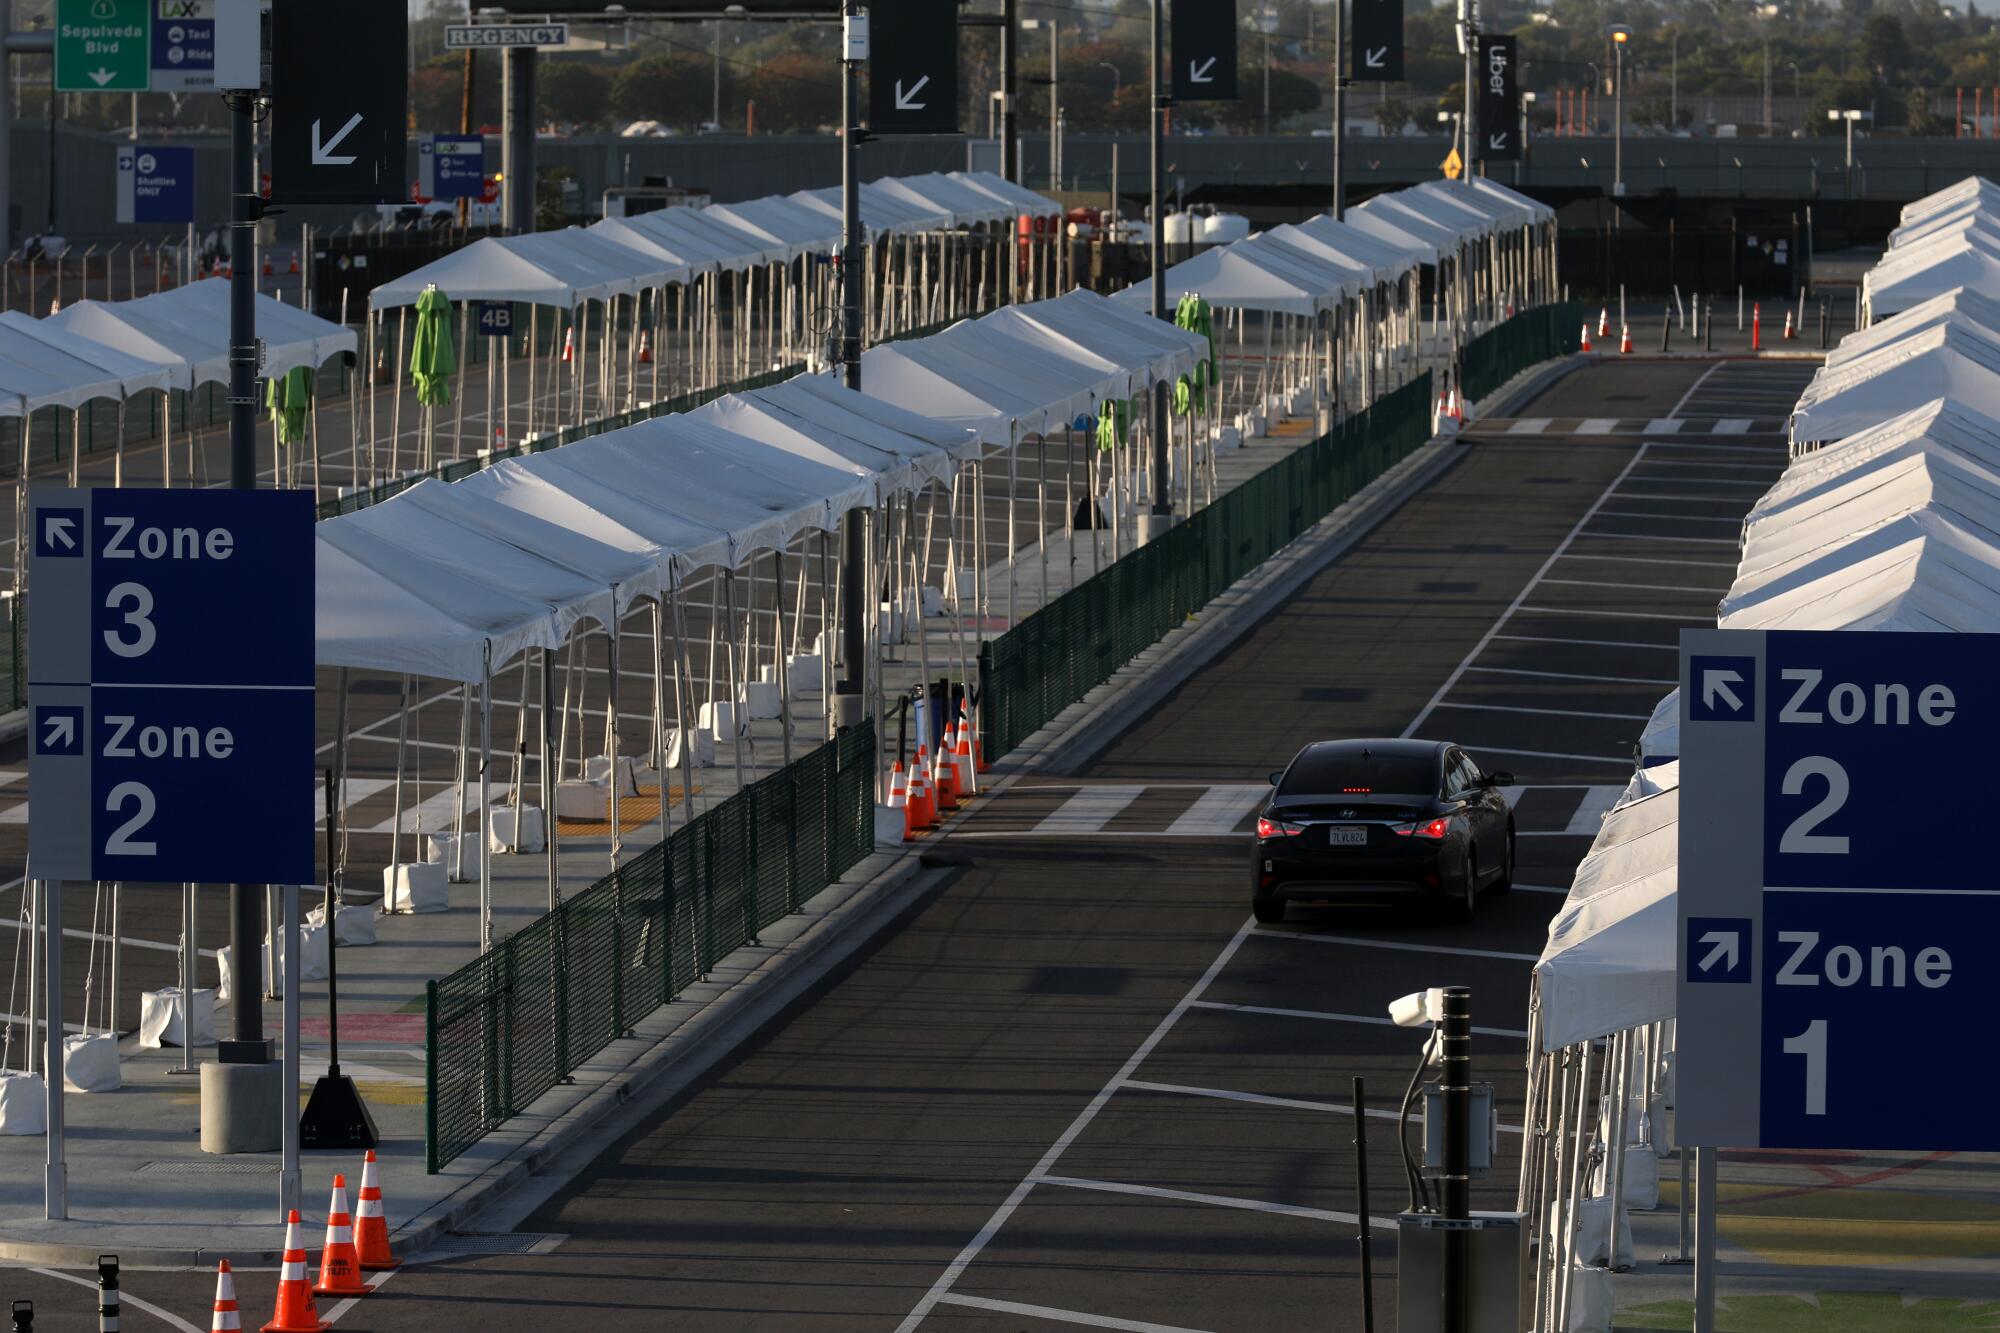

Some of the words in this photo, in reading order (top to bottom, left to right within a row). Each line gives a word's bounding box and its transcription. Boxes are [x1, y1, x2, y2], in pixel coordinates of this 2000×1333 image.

[62, 25, 142, 38] Sepulveda
[85, 41, 119, 53] Blvd
[187, 29, 210, 40] Taxi
[449, 28, 561, 44] REGENCY
[187, 50, 213, 60] Ride
[1489, 45, 1507, 96] Uber
[184, 77, 214, 86] SECON
[137, 187, 160, 196] ONLY
[481, 309, 511, 327] 4B
[103, 516, 234, 560] Zone
[103, 582, 157, 658] 3
[1780, 668, 1956, 727] Zone
[103, 715, 234, 759] Zone
[104, 781, 157, 856] 2
[1780, 756, 1850, 855] 2
[1776, 930, 1953, 990] Zone
[1783, 1020, 1828, 1116] 1
